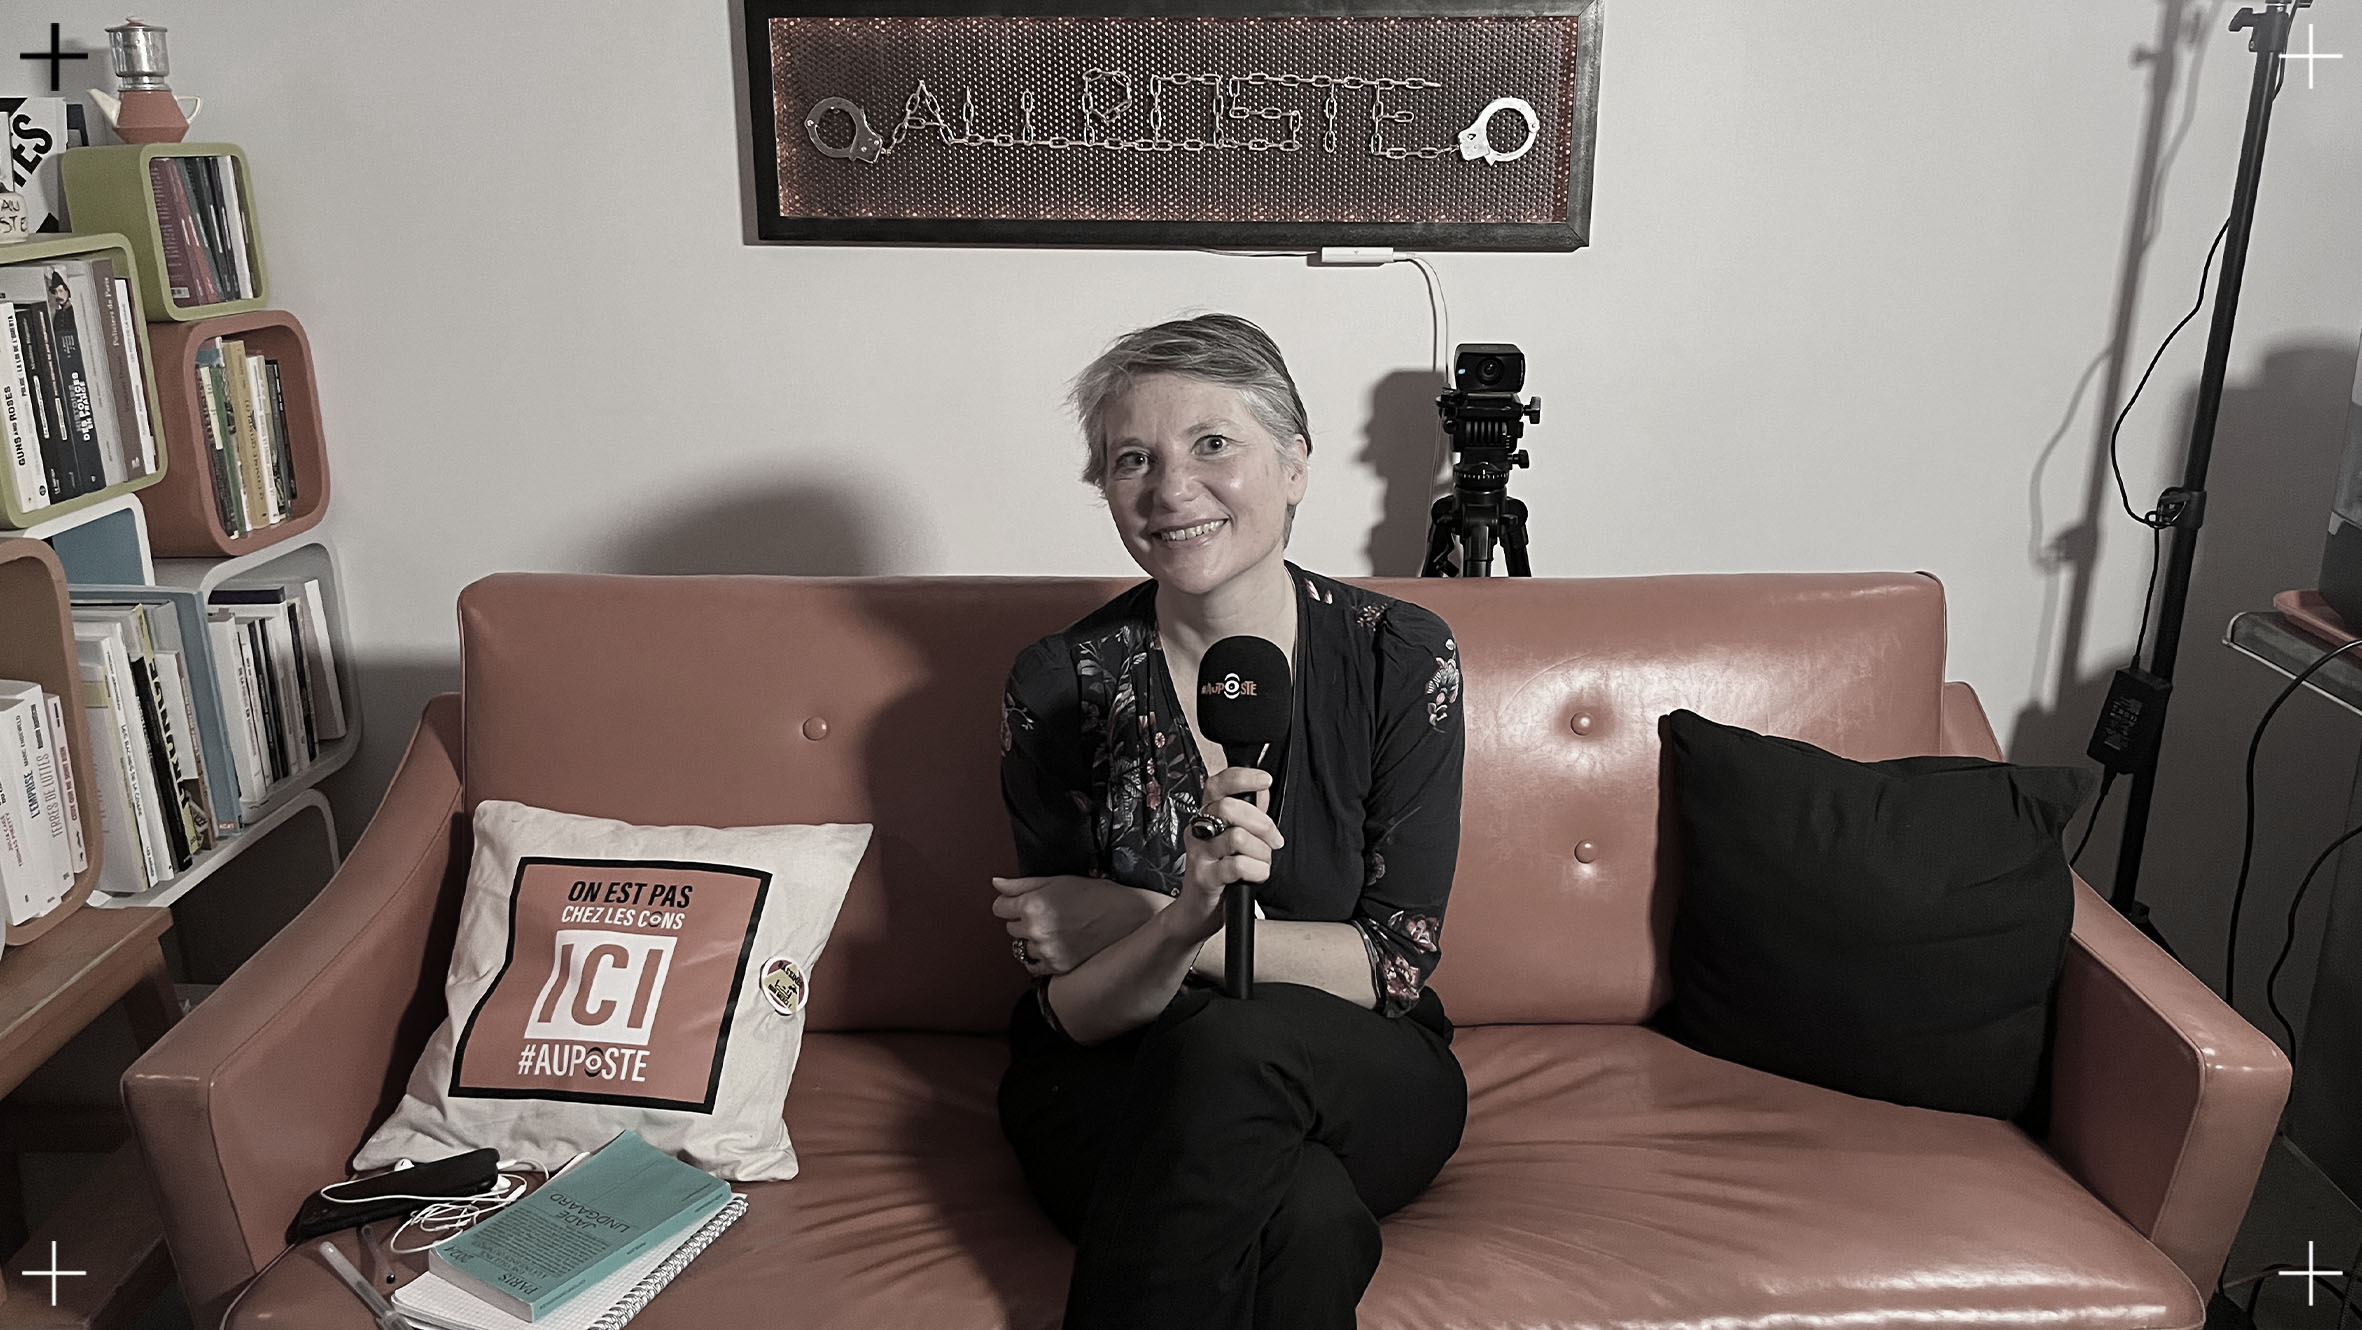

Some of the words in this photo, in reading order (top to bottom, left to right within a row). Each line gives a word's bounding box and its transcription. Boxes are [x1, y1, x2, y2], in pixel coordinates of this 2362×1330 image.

[102, 276, 112, 297] Paris
[106, 298, 114, 309] de
[106, 310, 121, 346] Policiers
[14, 344, 20, 352] DE
[17, 364, 23, 373] LA
[4, 385, 17, 421] ROSES
[70, 371, 86, 416] POLICES
[78, 380, 91, 415] FRANCE
[68, 384, 82, 431] HISTOIRE
[79, 416, 91, 441] DES
[86, 417, 94, 429] EN
[14, 436, 26, 466] GUNS
[15, 715, 26, 747] ENDEWELD
[22, 749, 30, 766] MARC
[36, 753, 52, 787] LUTTES
[24, 770, 40, 818] L'EMPRISE
[43, 787, 56, 801] DE
[66, 790, 75, 803] QUI
[47, 801, 64, 838] TERRES
[13, 840, 22, 866] THOMAS
[568, 881, 602, 902] ON
[604, 882, 647, 905] EST
[648, 884, 693, 908] PAS
[561, 906, 604, 923] CHEZ
[604, 909, 640, 926] LES
[637, 911, 685, 930] CONS
[537, 942, 664, 1030] ICI
[518, 1044, 650, 1083] #AUPOSTE
[550, 1193, 630, 1232] LINDGAARD
[556, 1210, 597, 1229] JADE
[444, 1245, 474, 1264] 2024
[498, 1273, 539, 1296] PARIS
